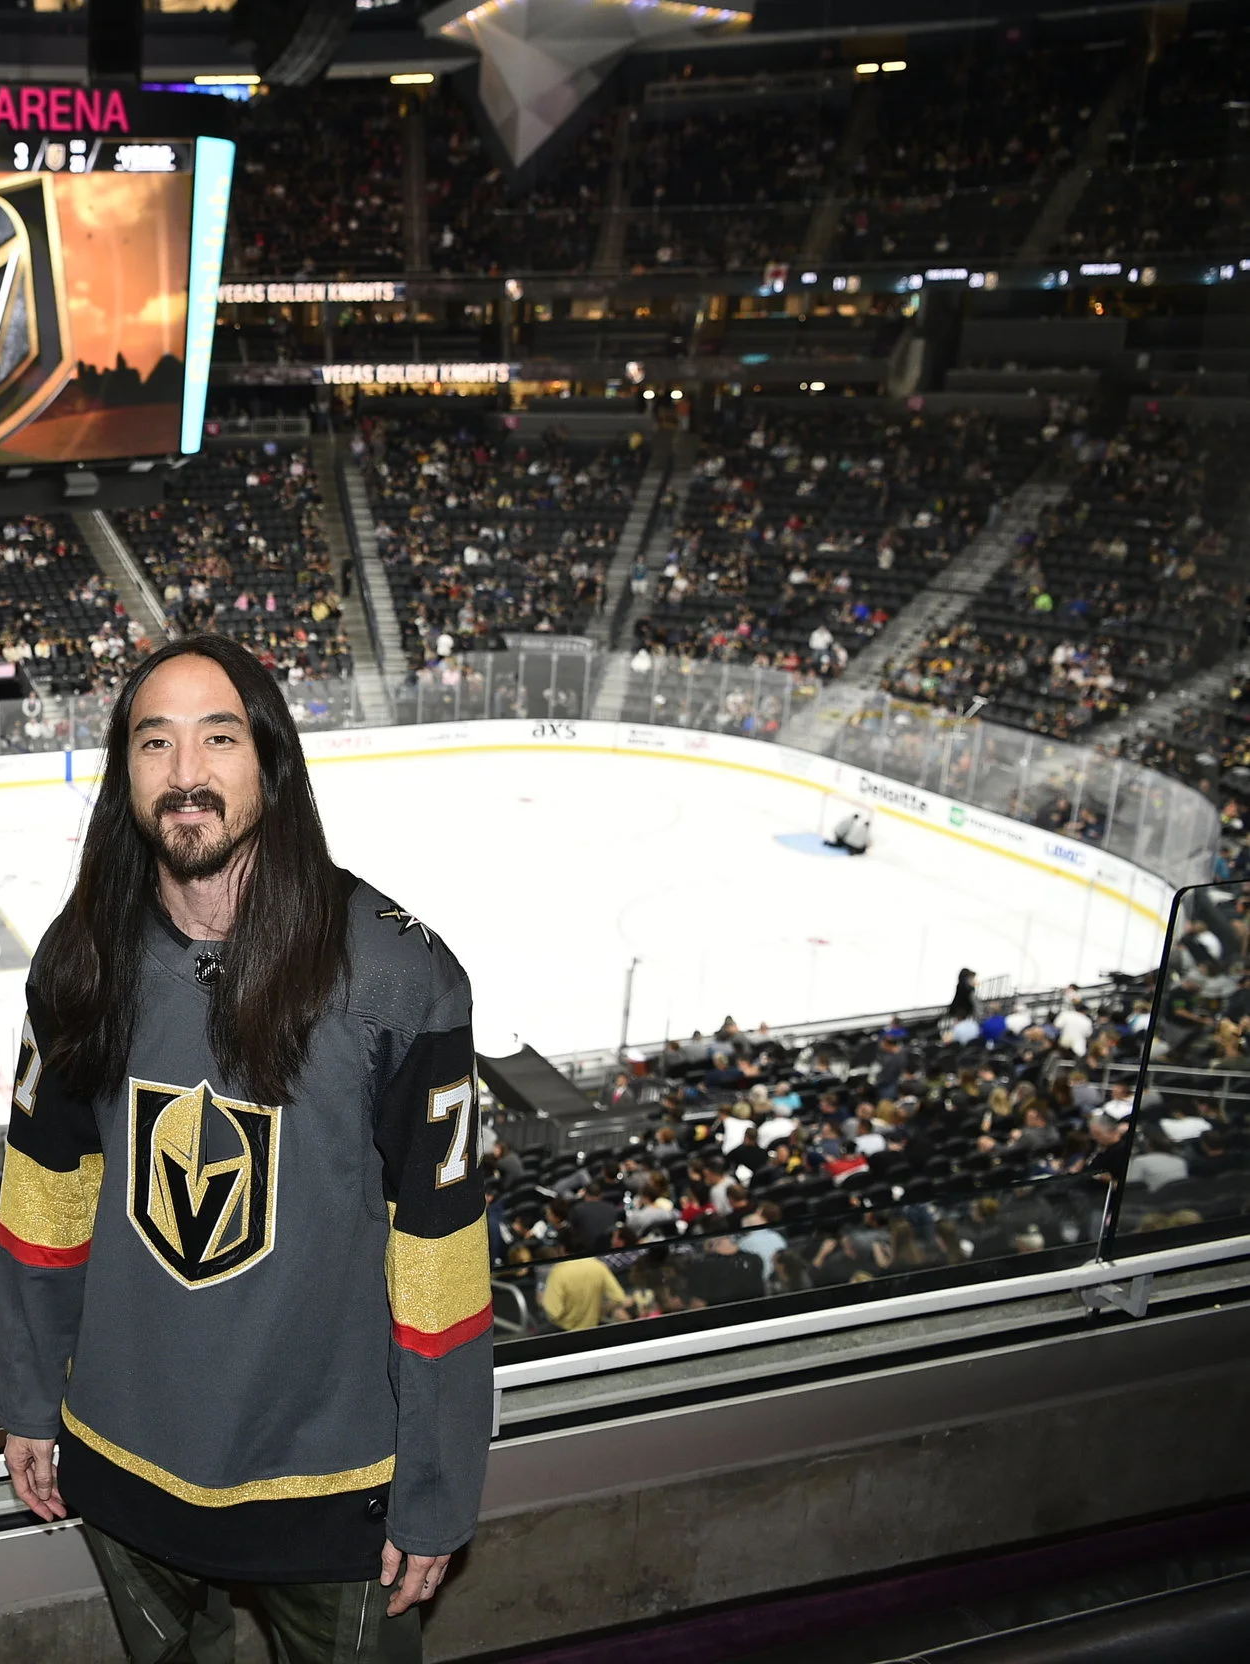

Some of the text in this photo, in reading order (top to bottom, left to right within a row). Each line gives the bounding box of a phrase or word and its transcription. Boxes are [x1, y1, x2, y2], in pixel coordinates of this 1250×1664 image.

[217, 281, 396, 303] VEGAS GOLDEN KNIGHTS
[321, 362, 511, 385] VEGAS GOLDEN KNIGHTS
[858, 776, 929, 813] Deloitte
[427, 1060, 483, 1190] 7
